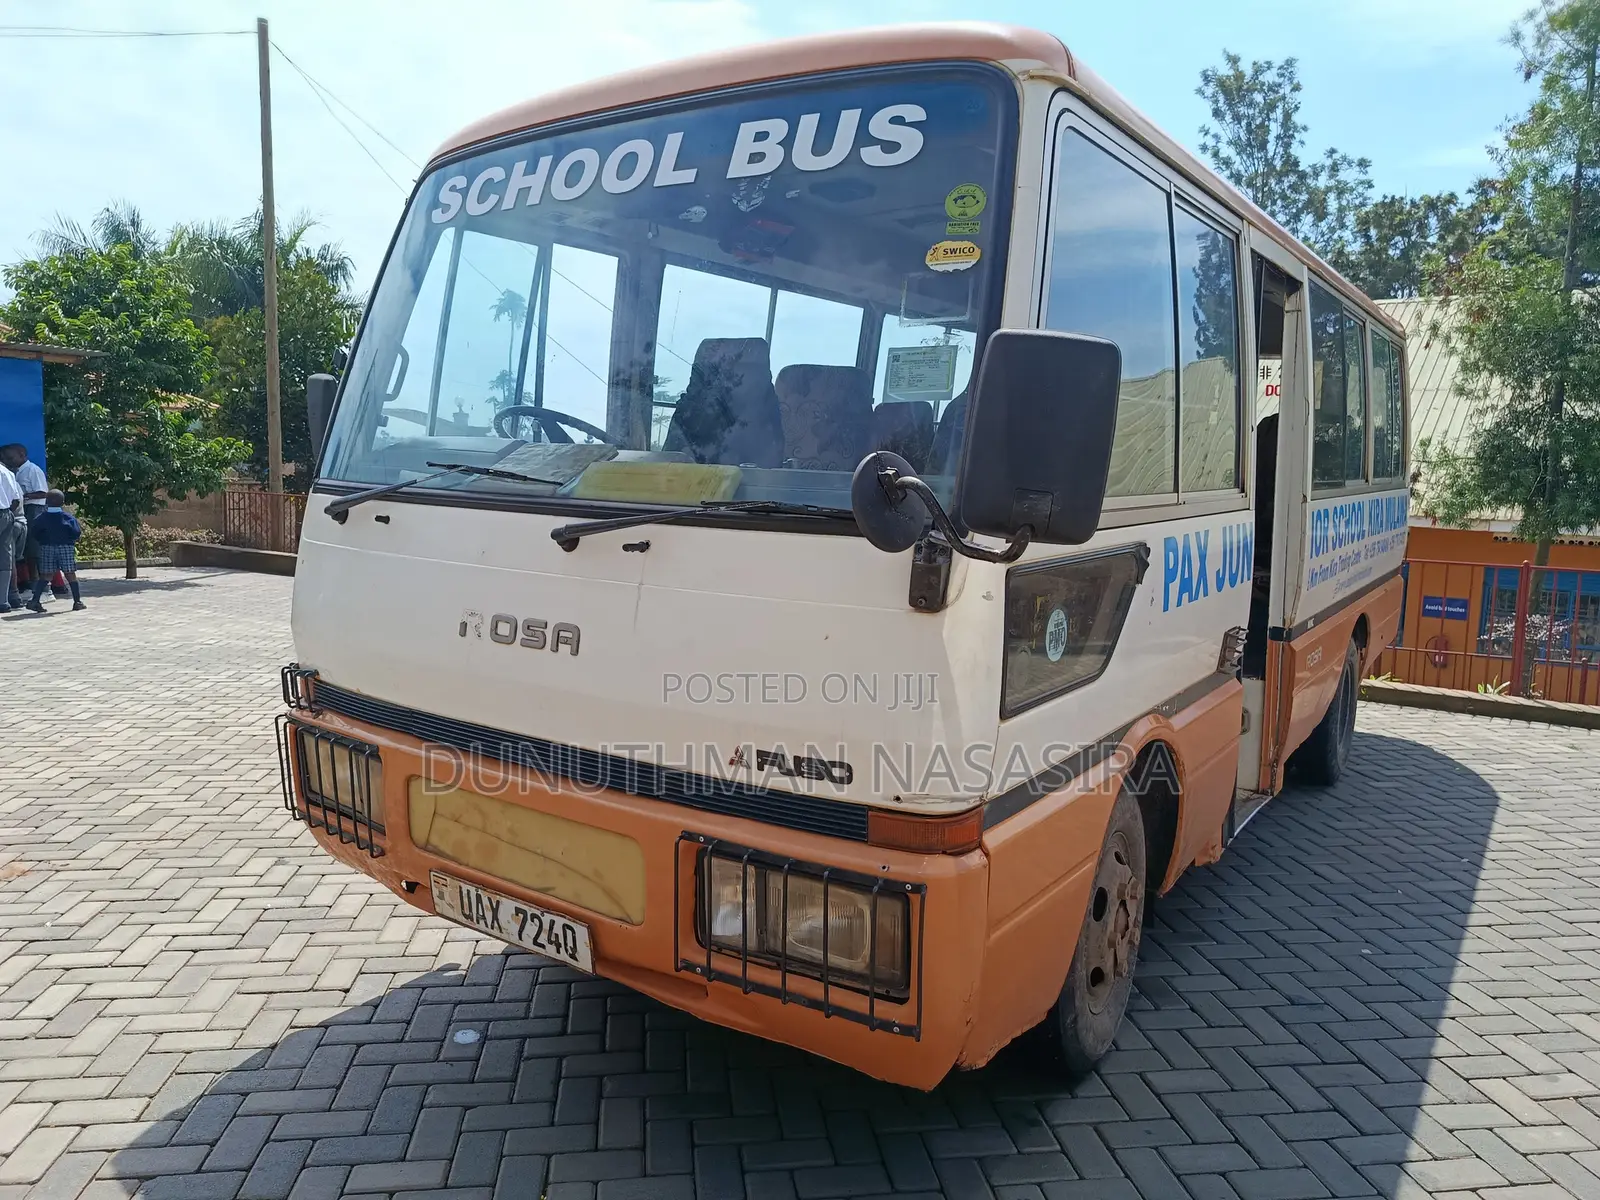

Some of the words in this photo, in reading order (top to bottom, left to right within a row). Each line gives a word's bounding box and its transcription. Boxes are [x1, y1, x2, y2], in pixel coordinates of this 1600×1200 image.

[431, 131, 699, 225] SCHOOL
[726, 103, 929, 181] BUS
[942, 246, 975, 256] SWICO
[1163, 529, 1209, 612] PAX
[1331, 501, 1366, 551] SCHOOL
[1367, 498, 1384, 538] KIRA
[756, 749, 853, 785] FUSO
[458, 884, 503, 934] UAX
[514, 906, 579, 962] 724Q
